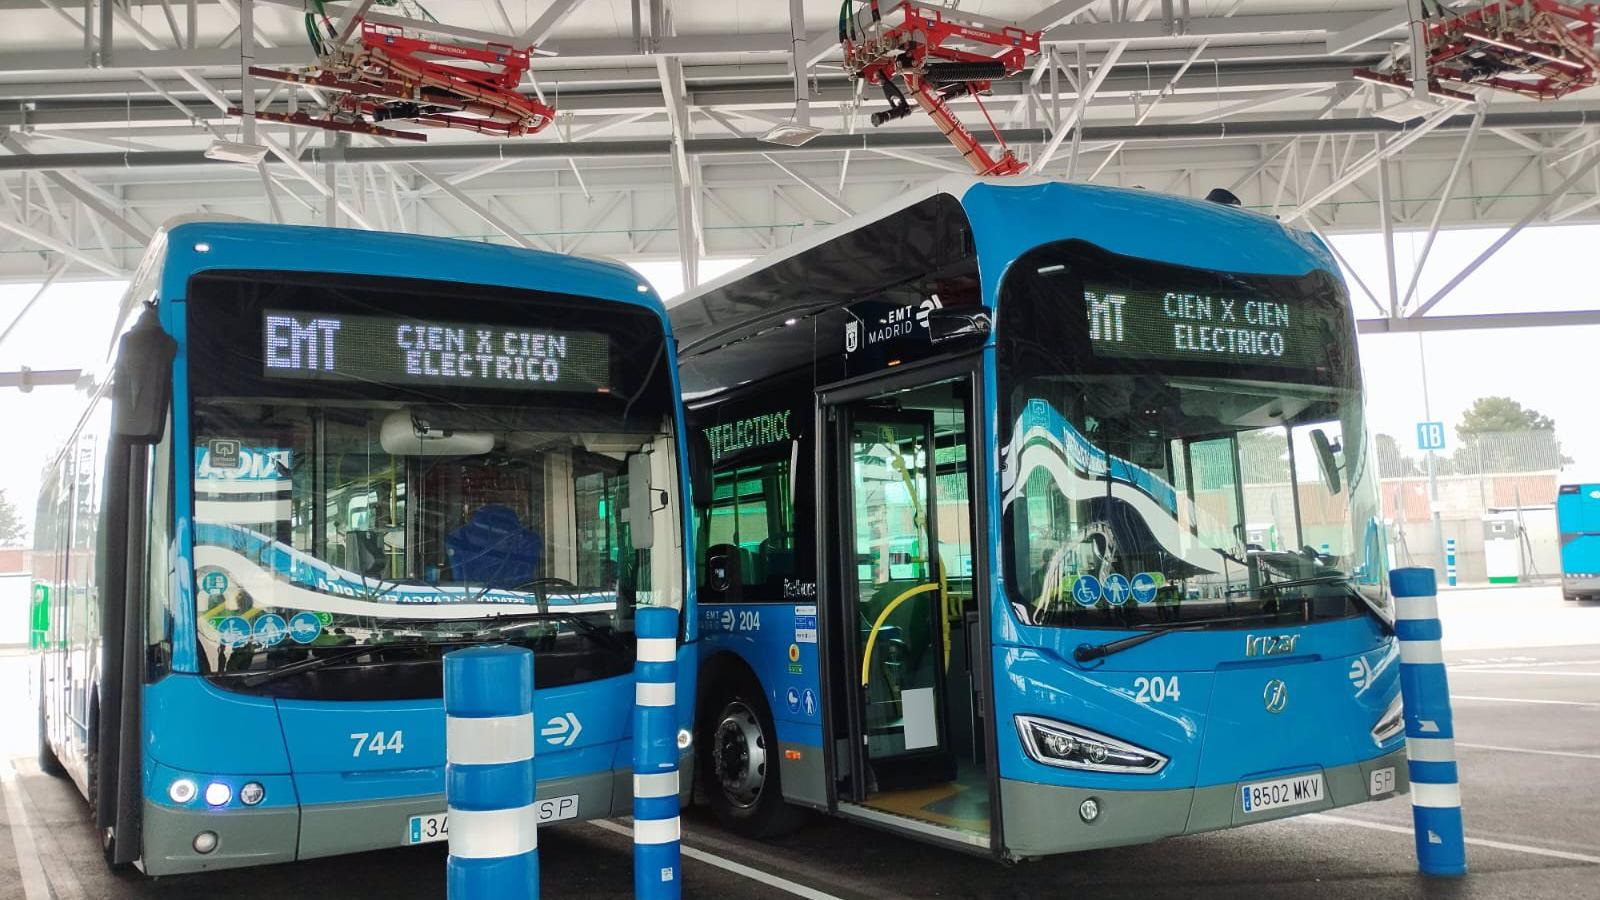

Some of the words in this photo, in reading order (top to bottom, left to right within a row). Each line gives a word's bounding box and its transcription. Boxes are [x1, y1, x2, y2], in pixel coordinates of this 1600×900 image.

[888, 305, 913, 323] EMT
[1085, 292, 1126, 341] MT
[1164, 293, 1211, 320] CIEN
[1221, 298, 1235, 322] X
[1244, 301, 1289, 327] CIEN
[266, 315, 341, 370] EMT
[398, 325, 465, 352] CIEN
[476, 330, 492, 354] X
[504, 332, 566, 358] CIEN
[868, 320, 913, 344] MADRID
[1174, 324, 1285, 356] ELECTRICO
[406, 351, 560, 382] ELECTRICO
[1420, 424, 1442, 448] 1B
[740, 610, 760, 631] 204
[1133, 675, 1181, 703] 204
[350, 730, 404, 757] 744
[1253, 784, 1289, 807] 8502
[1294, 778, 1319, 800] MKV
[1375, 771, 1393, 791] SP
[540, 798, 573, 820] SP
